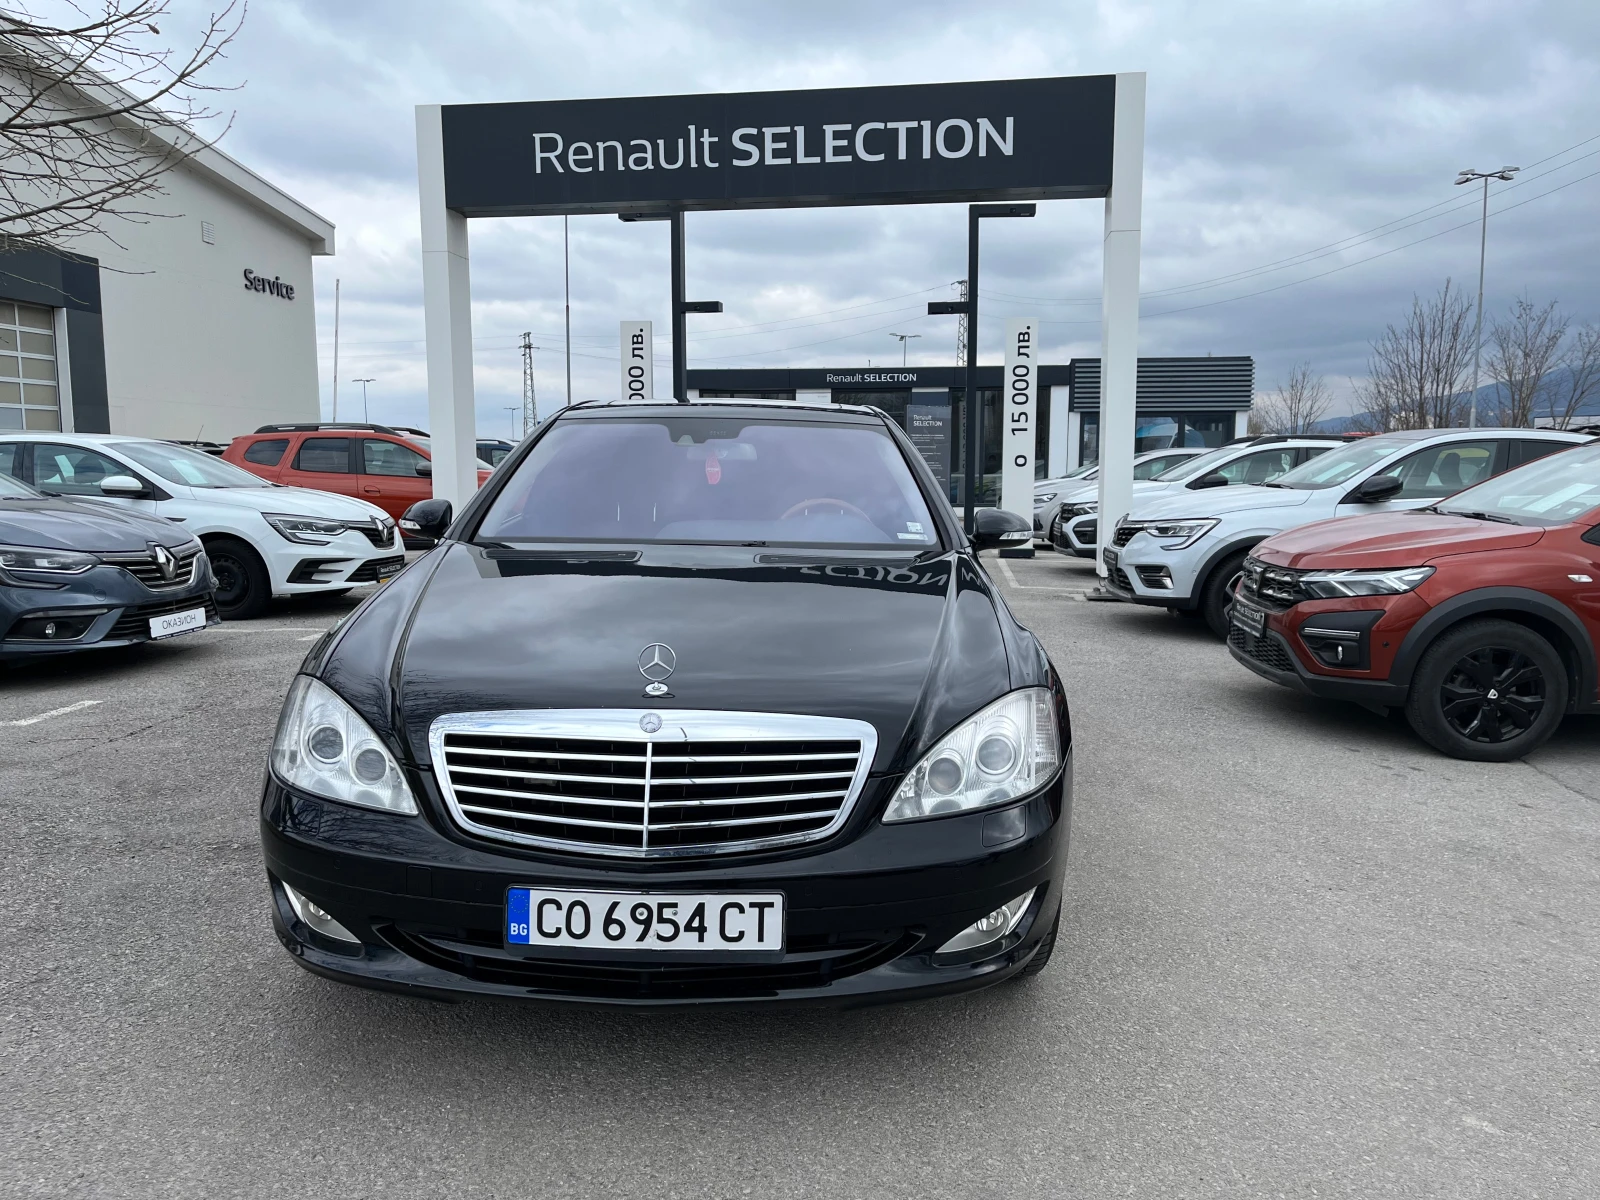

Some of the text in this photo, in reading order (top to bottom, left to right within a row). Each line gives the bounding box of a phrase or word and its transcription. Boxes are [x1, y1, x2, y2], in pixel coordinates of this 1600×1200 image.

[532, 116, 1015, 174] Renault SELECTION
[243, 268, 295, 300] Service
[826, 373, 917, 382] Renault SELECTION
[1012, 364, 1030, 405] 000
[1011, 411, 1029, 436] 15
[162, 614, 197, 630] ОКАЗИОН
[510, 922, 528, 936] BG
[536, 897, 775, 943] CO 6954 CT
